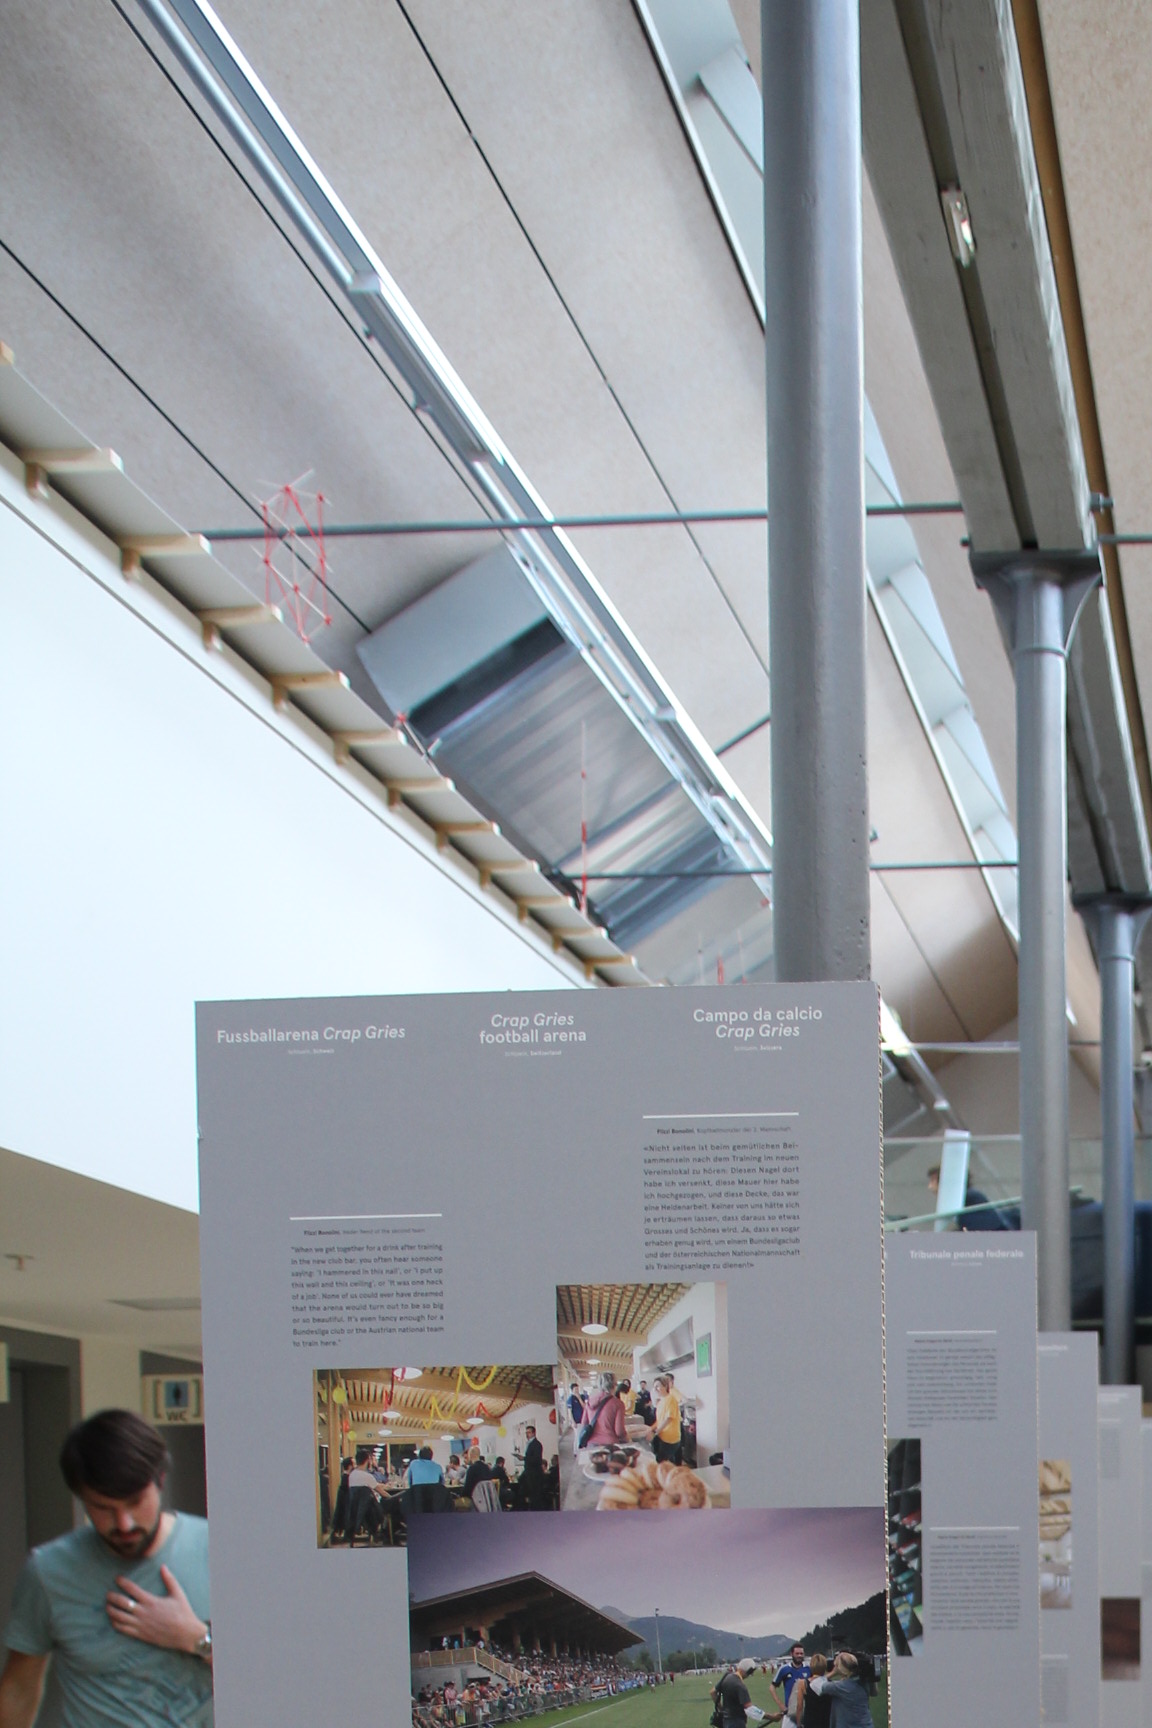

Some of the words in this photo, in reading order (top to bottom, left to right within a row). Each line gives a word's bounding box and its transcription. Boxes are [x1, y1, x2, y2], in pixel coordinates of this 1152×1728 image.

[491, 1014, 529, 1030] Crap
[533, 1012, 574, 1026] Gries
[693, 1009, 749, 1024] Campo
[753, 1007, 772, 1021] da
[776, 1006, 823, 1020] calcio
[217, 1028, 319, 1043] Fussballarena
[323, 1026, 361, 1043] Crap
[365, 1025, 406, 1039] Gries
[480, 1029, 539, 1044] football
[543, 1031, 587, 1043] arena
[716, 1024, 755, 1041] Crap
[759, 1023, 800, 1038] Gries
[909, 1250, 951, 1259] Tribunale
[953, 1250, 984, 1260] penale
[986, 1249, 1024, 1258] federale
[166, 1411, 188, 1422] WC
